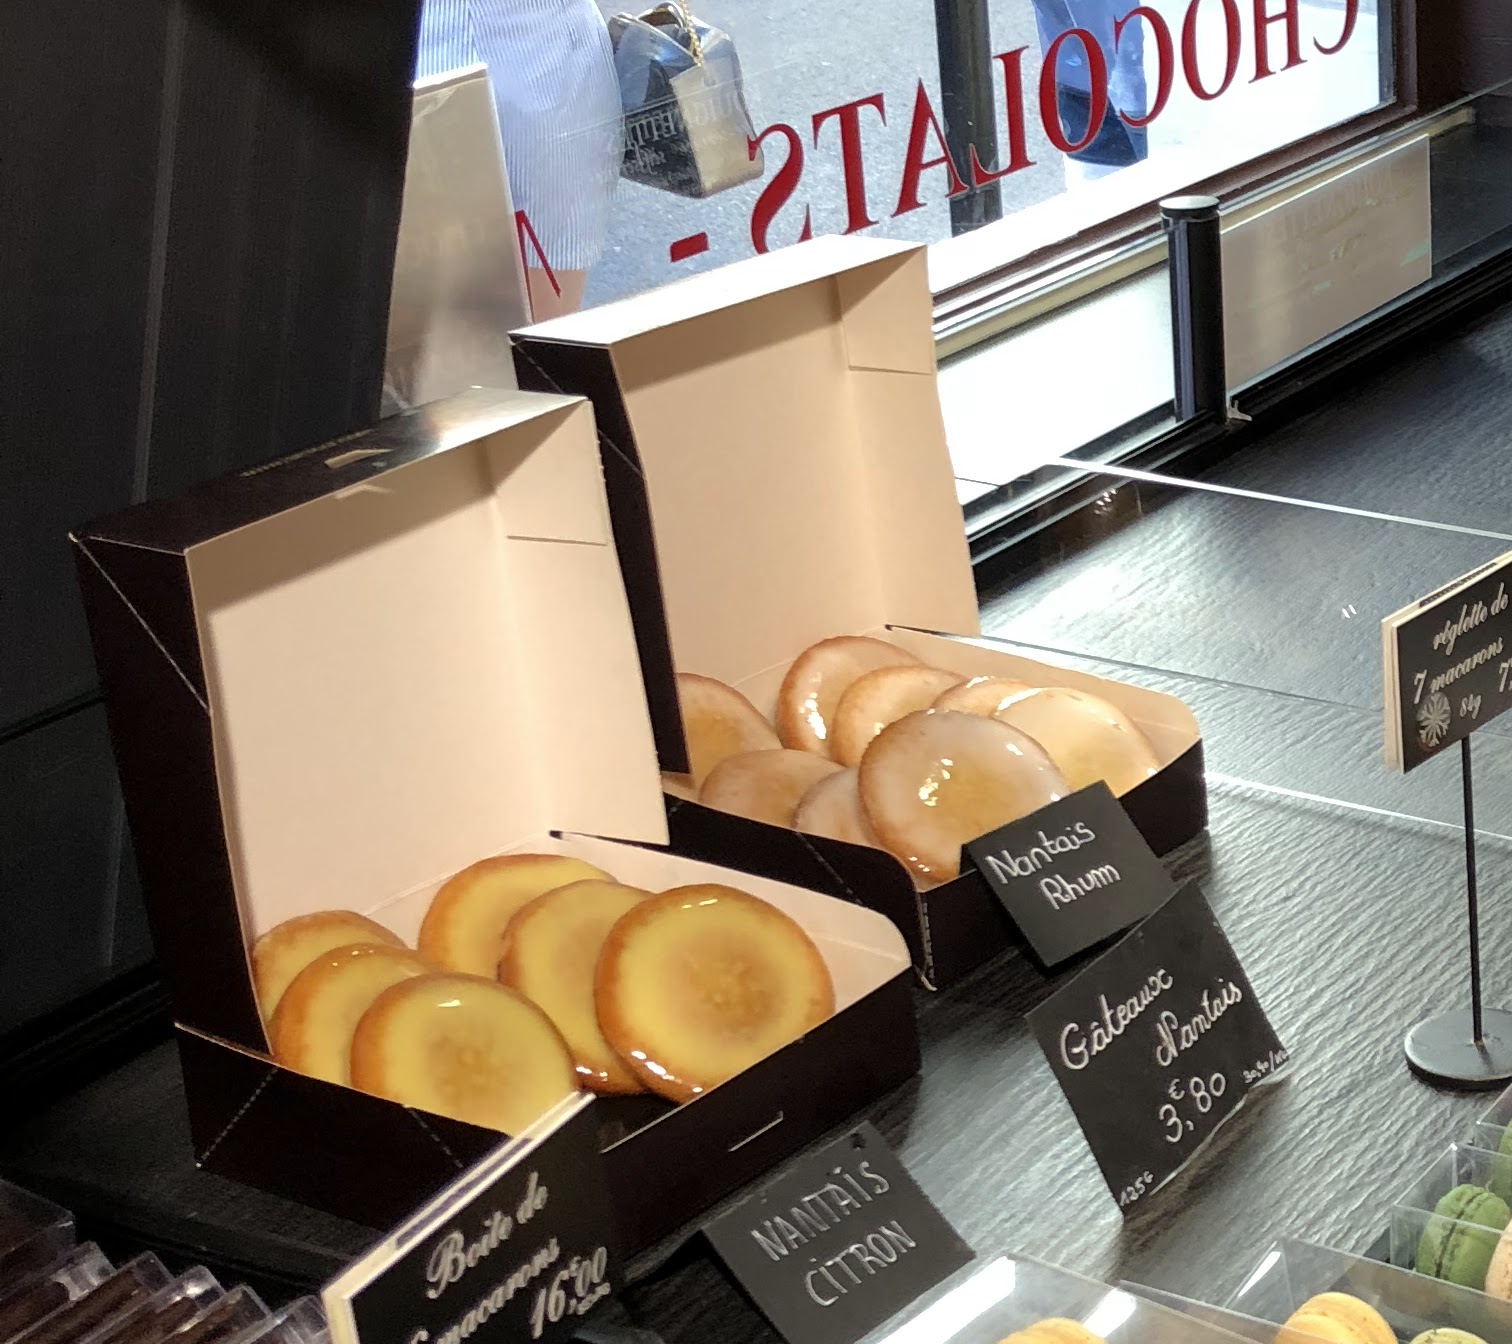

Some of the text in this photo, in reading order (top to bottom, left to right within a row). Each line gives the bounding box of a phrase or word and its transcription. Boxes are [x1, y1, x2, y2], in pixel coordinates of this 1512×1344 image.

[1491, 582, 1508, 616] de
[1414, 637, 1503, 704] 7 macarons
[985, 822, 1096, 884] Nantais
[1039, 863, 1121, 910] Rhum
[517, 1171, 549, 1224] de
